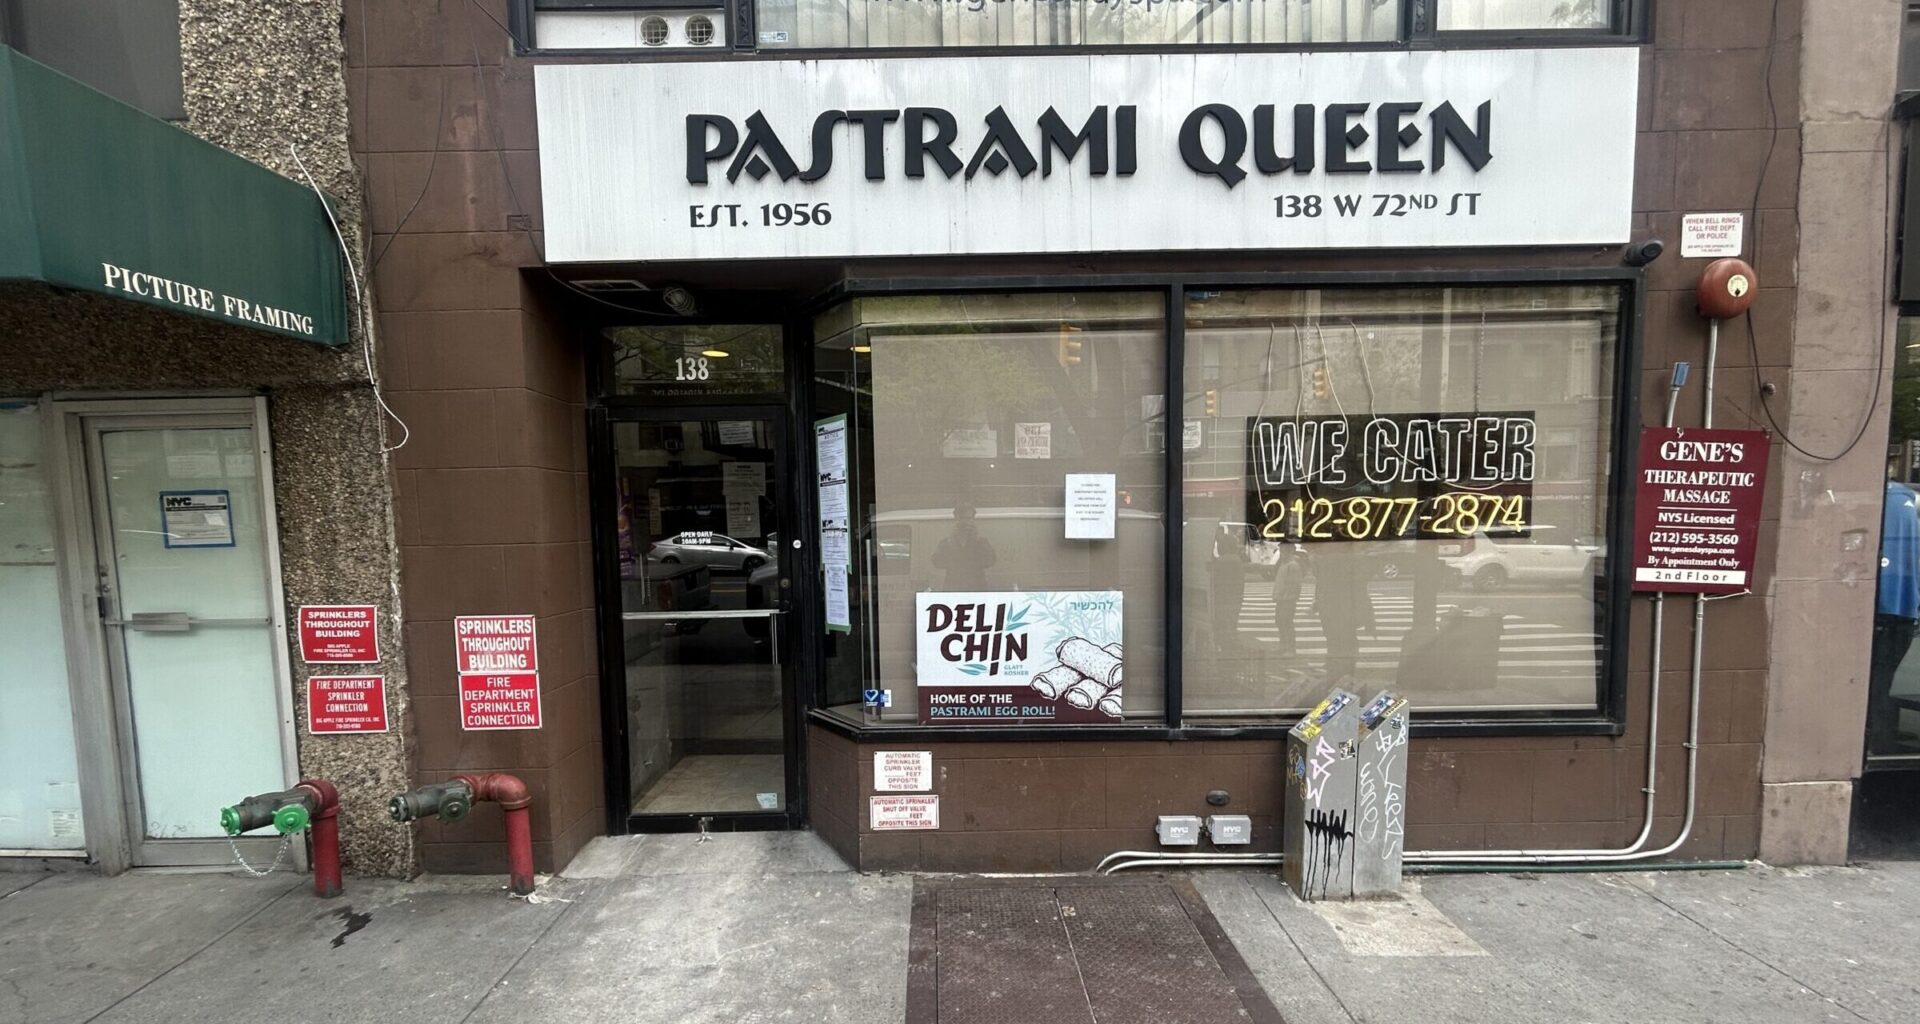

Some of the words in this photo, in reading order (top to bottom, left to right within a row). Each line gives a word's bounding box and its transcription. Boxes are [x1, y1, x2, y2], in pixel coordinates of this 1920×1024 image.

[686, 104, 1137, 186] PASTRAMI
[1178, 99, 1494, 188] QUEEN
[1273, 194, 1323, 218] 138
[1333, 194, 1363, 218] W
[1372, 192, 1438, 218] 72ND
[1445, 192, 1482, 217] ST
[689, 203, 749, 228] EST.
[760, 202, 832, 227] 1956
[101, 262, 216, 312] PICTURE
[221, 294, 314, 336] FRAMING
[674, 357, 710, 381] 138
[1258, 419, 1346, 485] WE
[1362, 416, 1537, 484] CATER
[1660, 440, 1744, 463] GENE'S
[1644, 468, 1755, 487] THERAPEUTIC
[166, 496, 192, 506] NYC
[1662, 488, 1731, 504] MASSAGE
[1262, 494, 1526, 539] 212-877-2874
[1658, 512, 1682, 523] NYS
[1683, 513, 1735, 525] Licensed
[1649, 531, 1680, 544] (212)
[1681, 532, 1739, 546] 595-3560
[1651, 545, 1735, 555] www.genesdayspa.com
[1648, 555, 1661, 567] By
[1661, 556, 1718, 568] Appointment
[1718, 557, 1740, 569] Only
[1655, 571, 1682, 580] 2nd
[1686, 571, 1728, 582] Floor
[1070, 600, 1114, 611] להכשיר
[308, 611, 367, 619] SPRINKLERS
[926, 603, 1006, 632] DELI
[305, 620, 371, 628] THROUGHOUT
[459, 619, 532, 634] SPRINKLERS
[315, 630, 361, 638] BUILDING
[461, 637, 531, 652] THROUGHOUT
[468, 653, 527, 668] BUILDING
[316, 680, 332, 689] FIRE
[333, 680, 375, 689] DEPARTMENT
[486, 677, 511, 687] FIRE
[327, 692, 365, 701] SPRINKLER
[464, 689, 535, 700] DEPARTMENT
[930, 694, 966, 704] HOME
[969, 694, 986, 704] OF
[989, 693, 1013, 703] THE
[325, 703, 369, 712] CONNECTION
[470, 702, 530, 713] SPRINKLER
[930, 706, 991, 716] PASTRAMI
[995, 706, 1018, 716] EGG
[1022, 705, 1056, 716] ROLL!
[467, 714, 535, 725] CONNECTION
